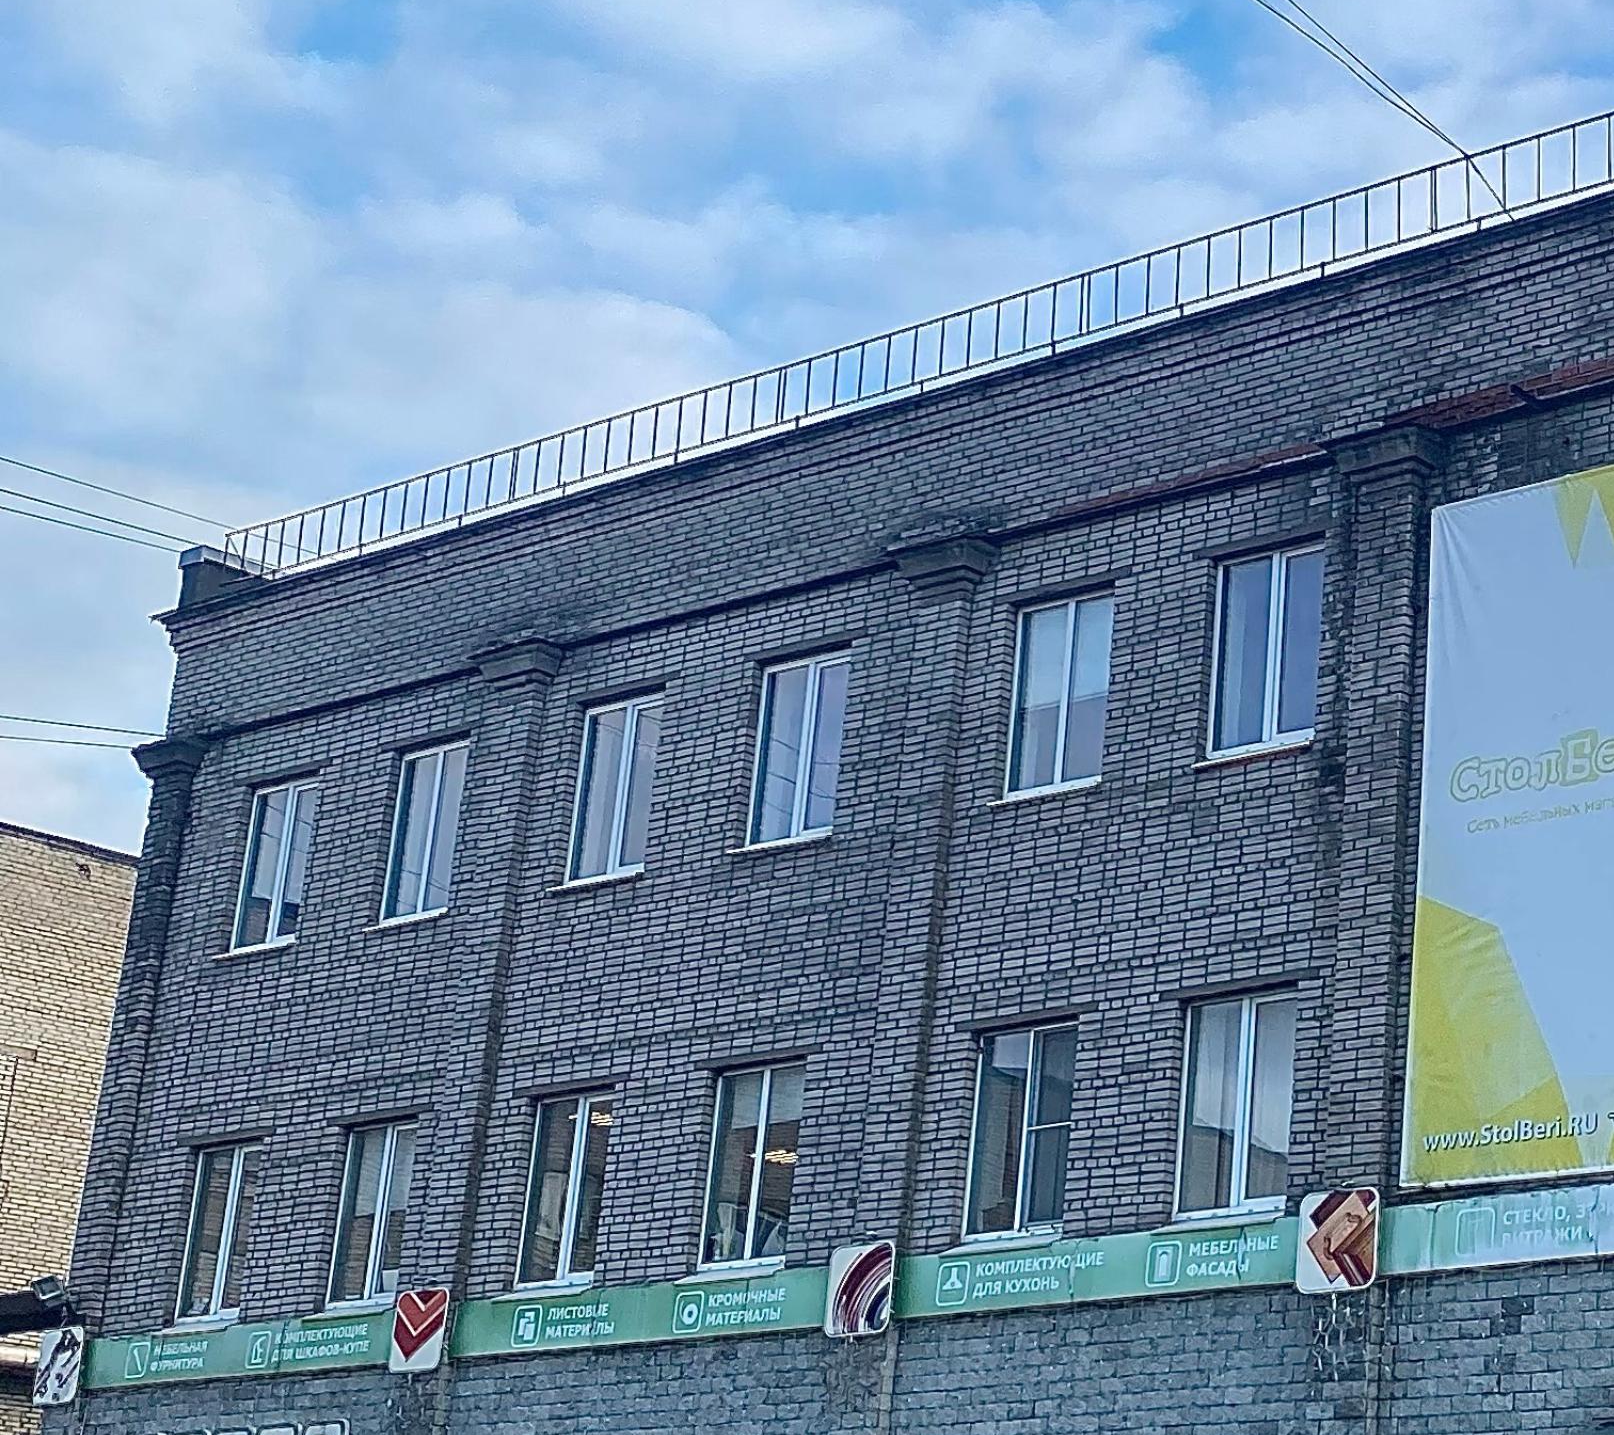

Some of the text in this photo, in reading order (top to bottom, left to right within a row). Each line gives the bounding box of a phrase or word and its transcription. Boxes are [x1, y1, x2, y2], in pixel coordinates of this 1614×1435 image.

[1423, 1113, 1598, 1152] www.StolBeri.RU
[1189, 1235, 1279, 1257] МЕБЕЛЬНЫЕ
[976, 1252, 1105, 1277] КОМПЛЕКТУЮЩИЕ
[1186, 1258, 1250, 1277] ФАСАДЫ
[708, 1288, 786, 1307] КРОМОЧНЫЕ
[973, 1276, 1060, 1299] ДЛЯ КУХОНЬ
[547, 1303, 609, 1320] ЛИСТОВЫЕ
[705, 1307, 781, 1326] МАТЕРИАЛЫ
